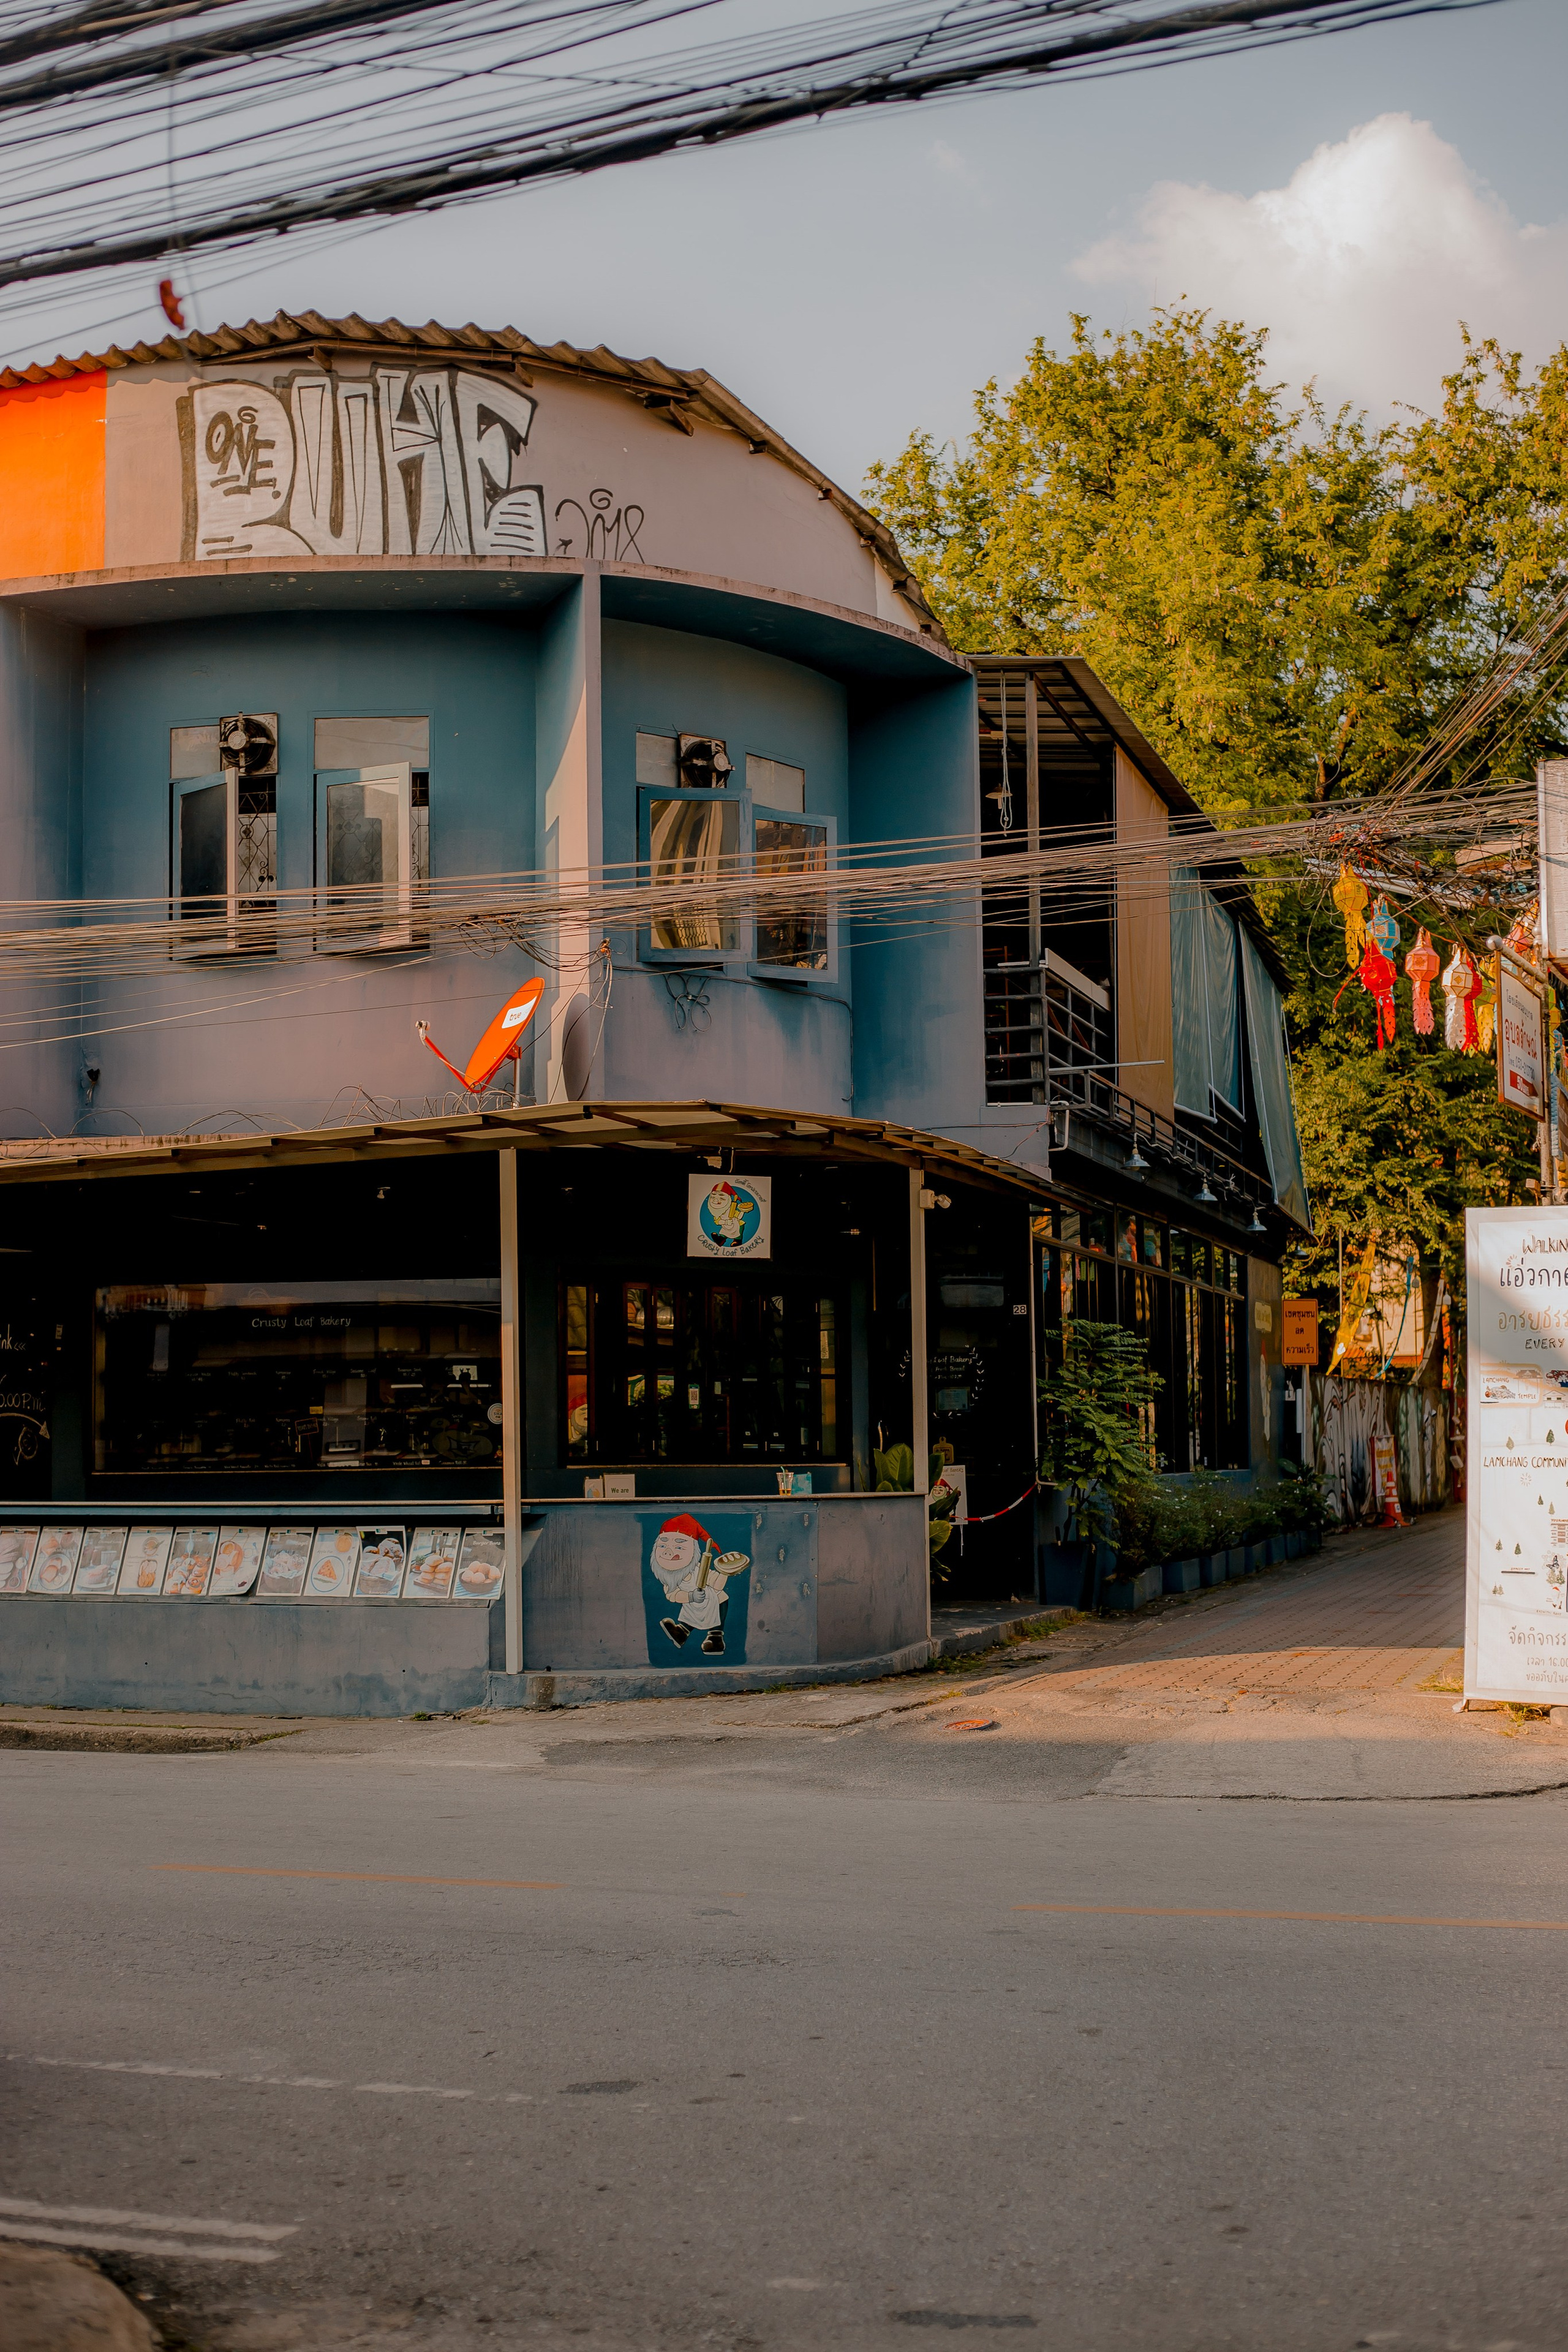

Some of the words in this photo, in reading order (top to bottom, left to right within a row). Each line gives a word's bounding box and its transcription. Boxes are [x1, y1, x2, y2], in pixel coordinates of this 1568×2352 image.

[509, 1012, 522, 1022] true
[1523, 1235, 1568, 1254] WALKIN
[1014, 1305, 1027, 1314] 28
[252, 1317, 287, 1328] Crusty
[295, 1316, 314, 1327] Loaf
[320, 1316, 351, 1327] Bakery
[1525, 1338, 1565, 1349] EVERY
[1483, 1457, 1528, 1468] LAMCHANG
[1531, 1457, 1568, 1468] COMMUNI
[1509, 1625, 1566, 1646] จัดกิจกรร
[1527, 1657, 1545, 1667] เวลา
